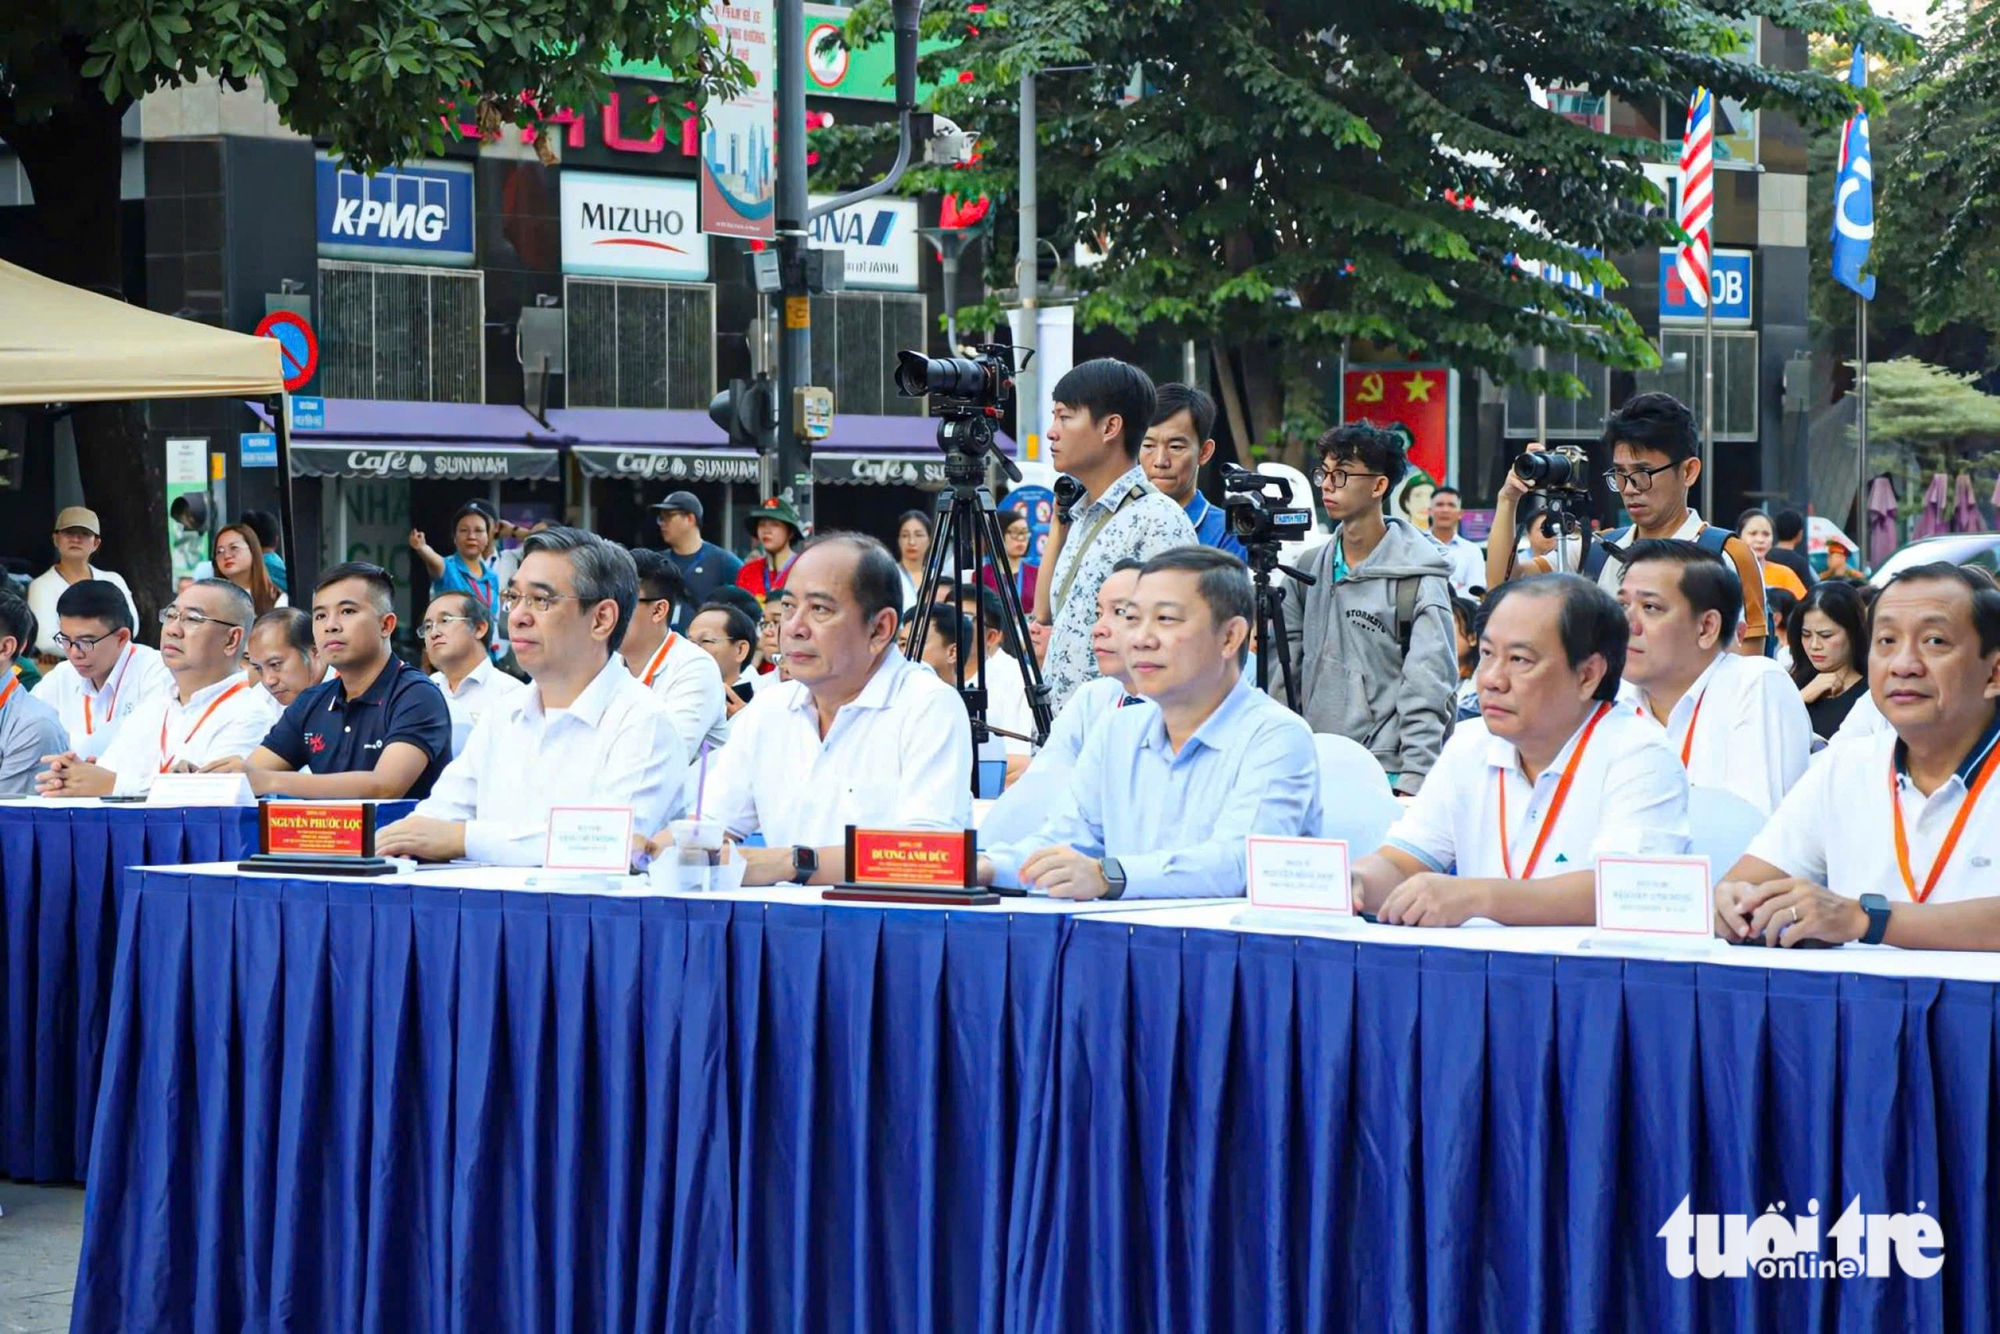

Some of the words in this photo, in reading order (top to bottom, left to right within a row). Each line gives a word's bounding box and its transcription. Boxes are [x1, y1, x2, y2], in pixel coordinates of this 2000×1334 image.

[331, 198, 446, 242] KPMG
[581, 202, 684, 235] MIZUHO
[347, 451, 407, 475] Café
